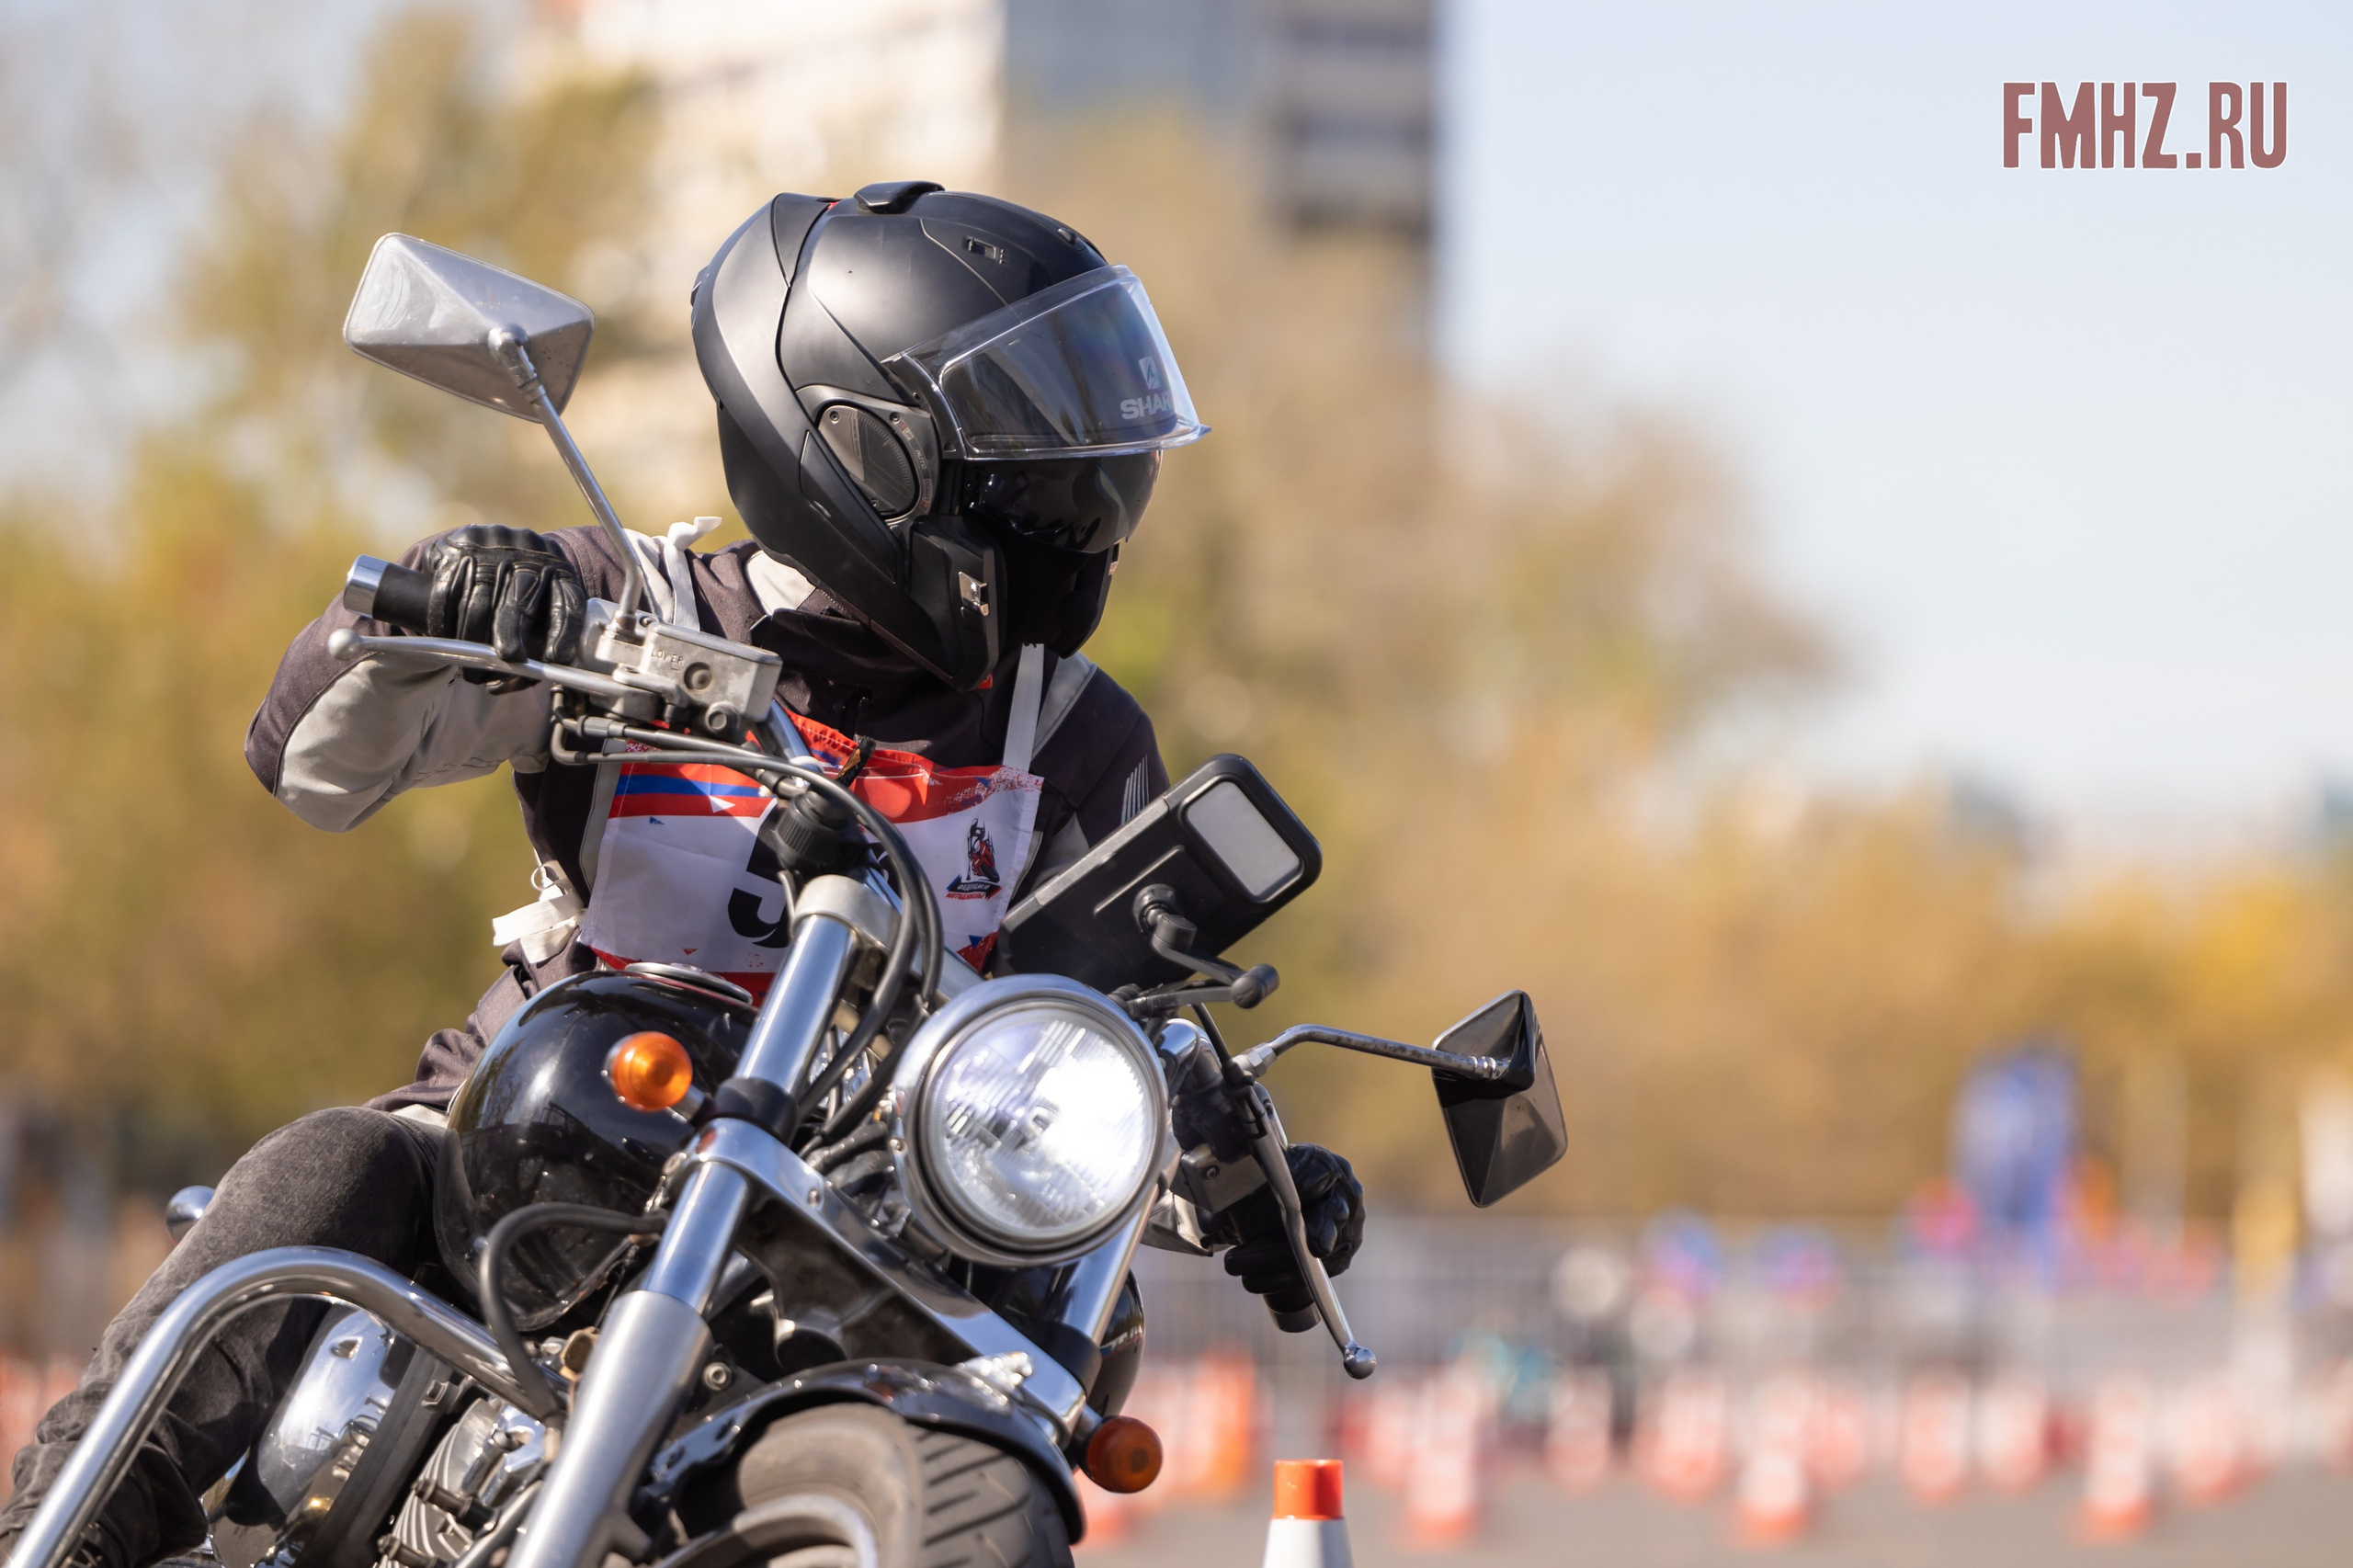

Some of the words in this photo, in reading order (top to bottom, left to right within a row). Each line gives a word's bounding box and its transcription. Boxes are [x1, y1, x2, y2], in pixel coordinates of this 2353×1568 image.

[1120, 390, 1172, 419] SHAR
[915, 449, 927, 470] AUTO
[651, 648, 684, 665] LOWER
